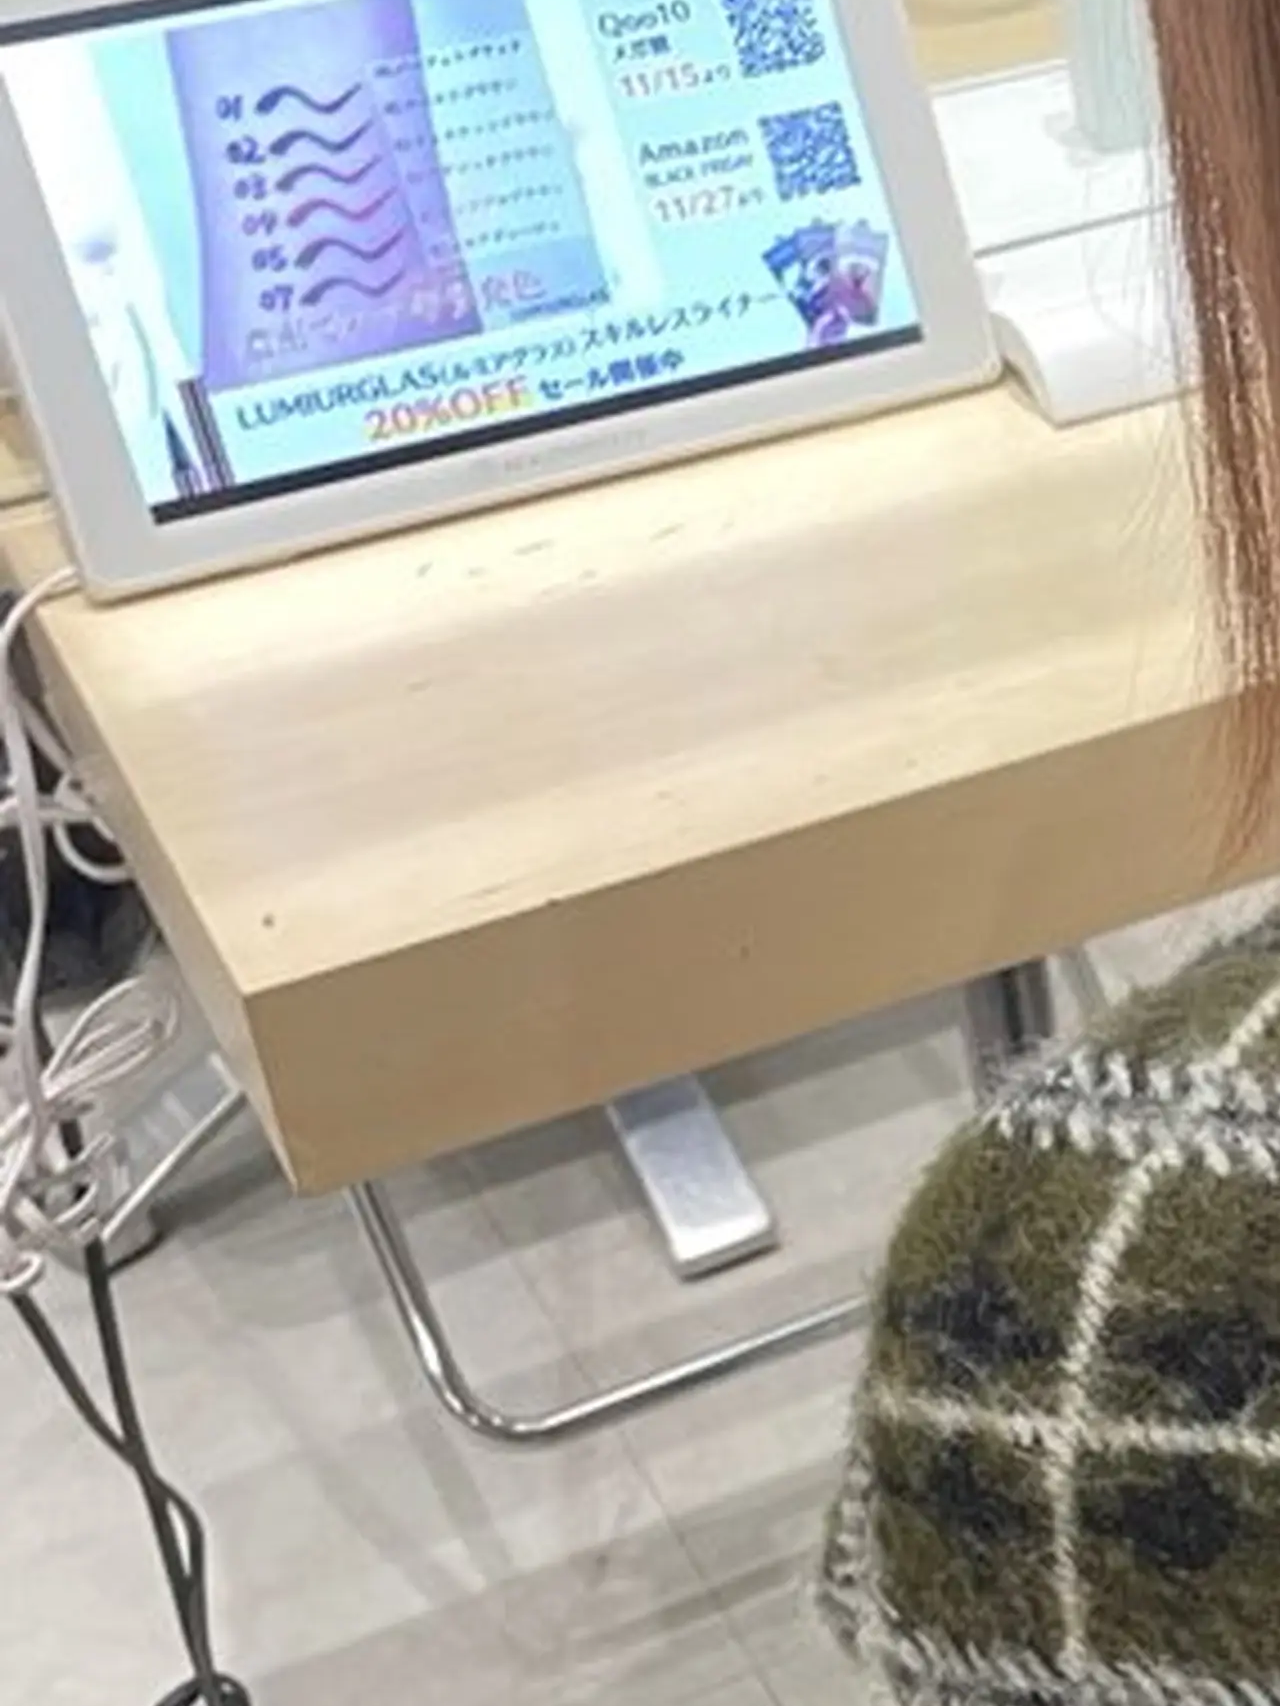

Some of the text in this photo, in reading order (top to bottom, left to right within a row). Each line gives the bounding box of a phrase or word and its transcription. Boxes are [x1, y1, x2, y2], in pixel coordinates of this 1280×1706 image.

[597, 0, 691, 38] Qoo10
[215, 94, 243, 122] 01
[225, 135, 267, 166] 02
[639, 129, 750, 167] Amazon
[258, 283, 295, 312] 07
[364, 373, 530, 443] 20%OFF
